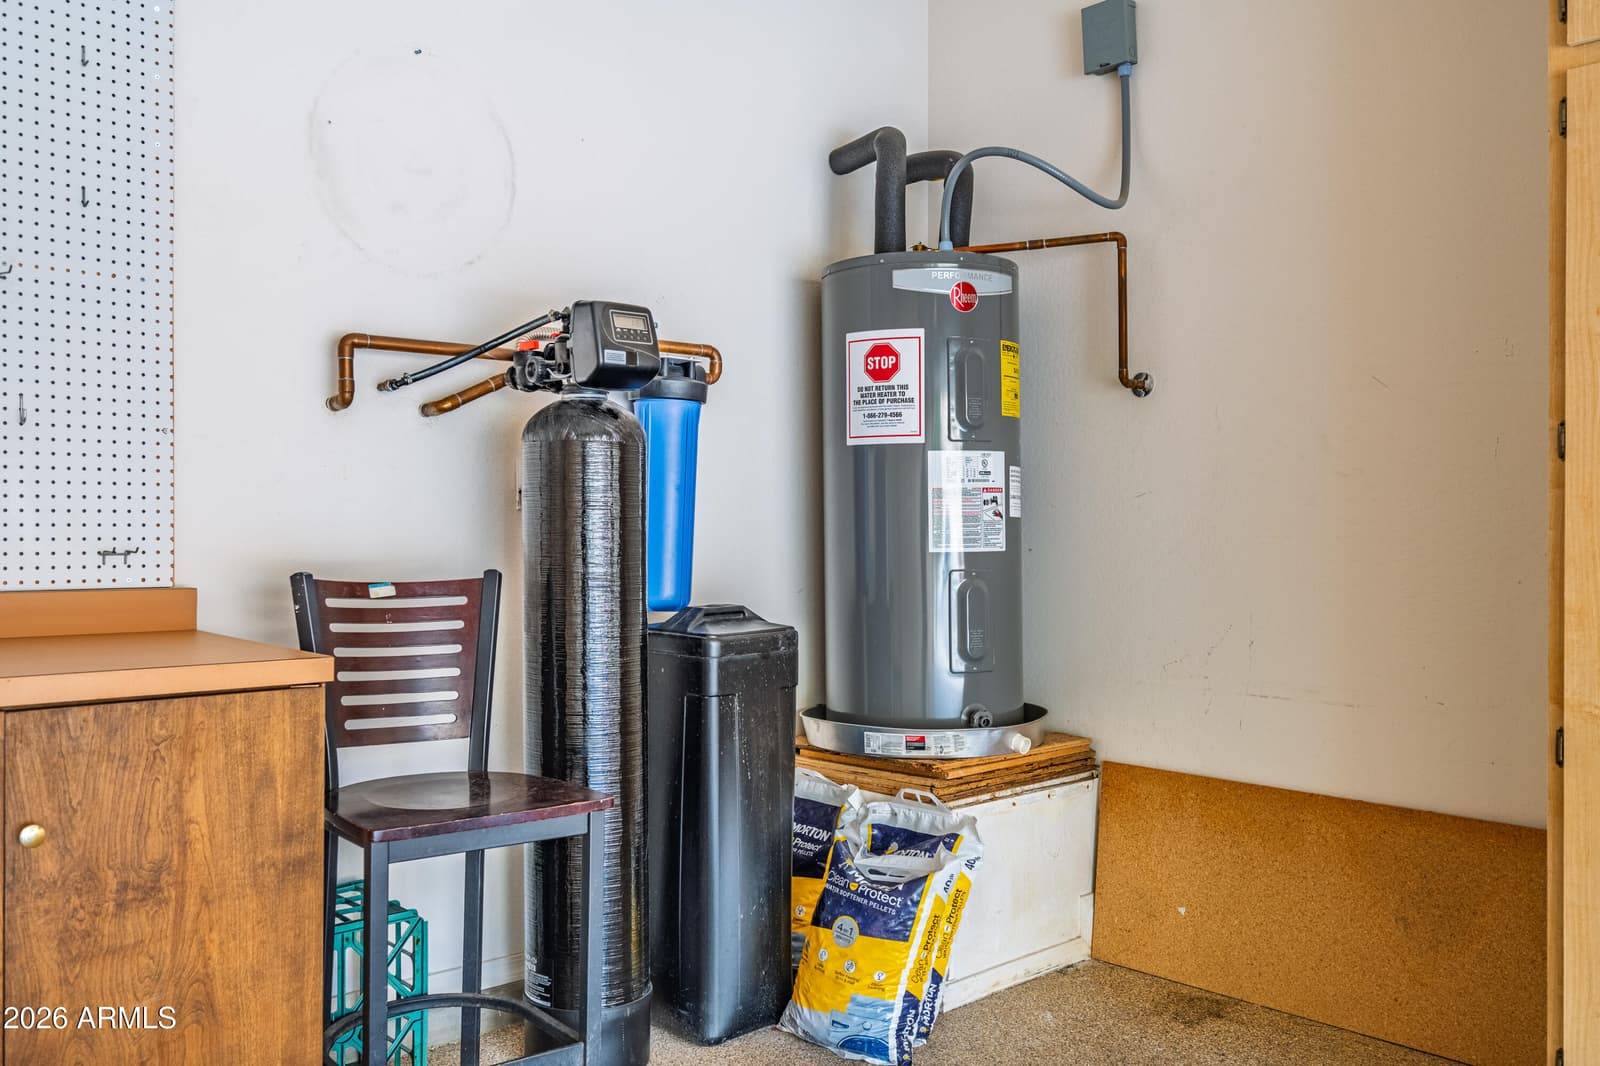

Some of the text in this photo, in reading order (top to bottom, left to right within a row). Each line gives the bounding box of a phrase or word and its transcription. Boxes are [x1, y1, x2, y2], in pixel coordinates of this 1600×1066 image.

[953, 281, 977, 308] Rheem
[867, 355, 897, 370] STOP
[792, 822, 832, 842] MORTON
[793, 837, 822, 852] Protect
[964, 858, 976, 871] 40
[827, 870, 849, 889] Clean
[857, 885, 903, 908] Protect
[839, 888, 868, 905] SOFTENER
[868, 901, 896, 915] PELLETS
[945, 889, 963, 924] Protect
[837, 922, 843, 931] 4
[923, 914, 940, 951] Protect
[922, 984, 937, 1026] MORTON
